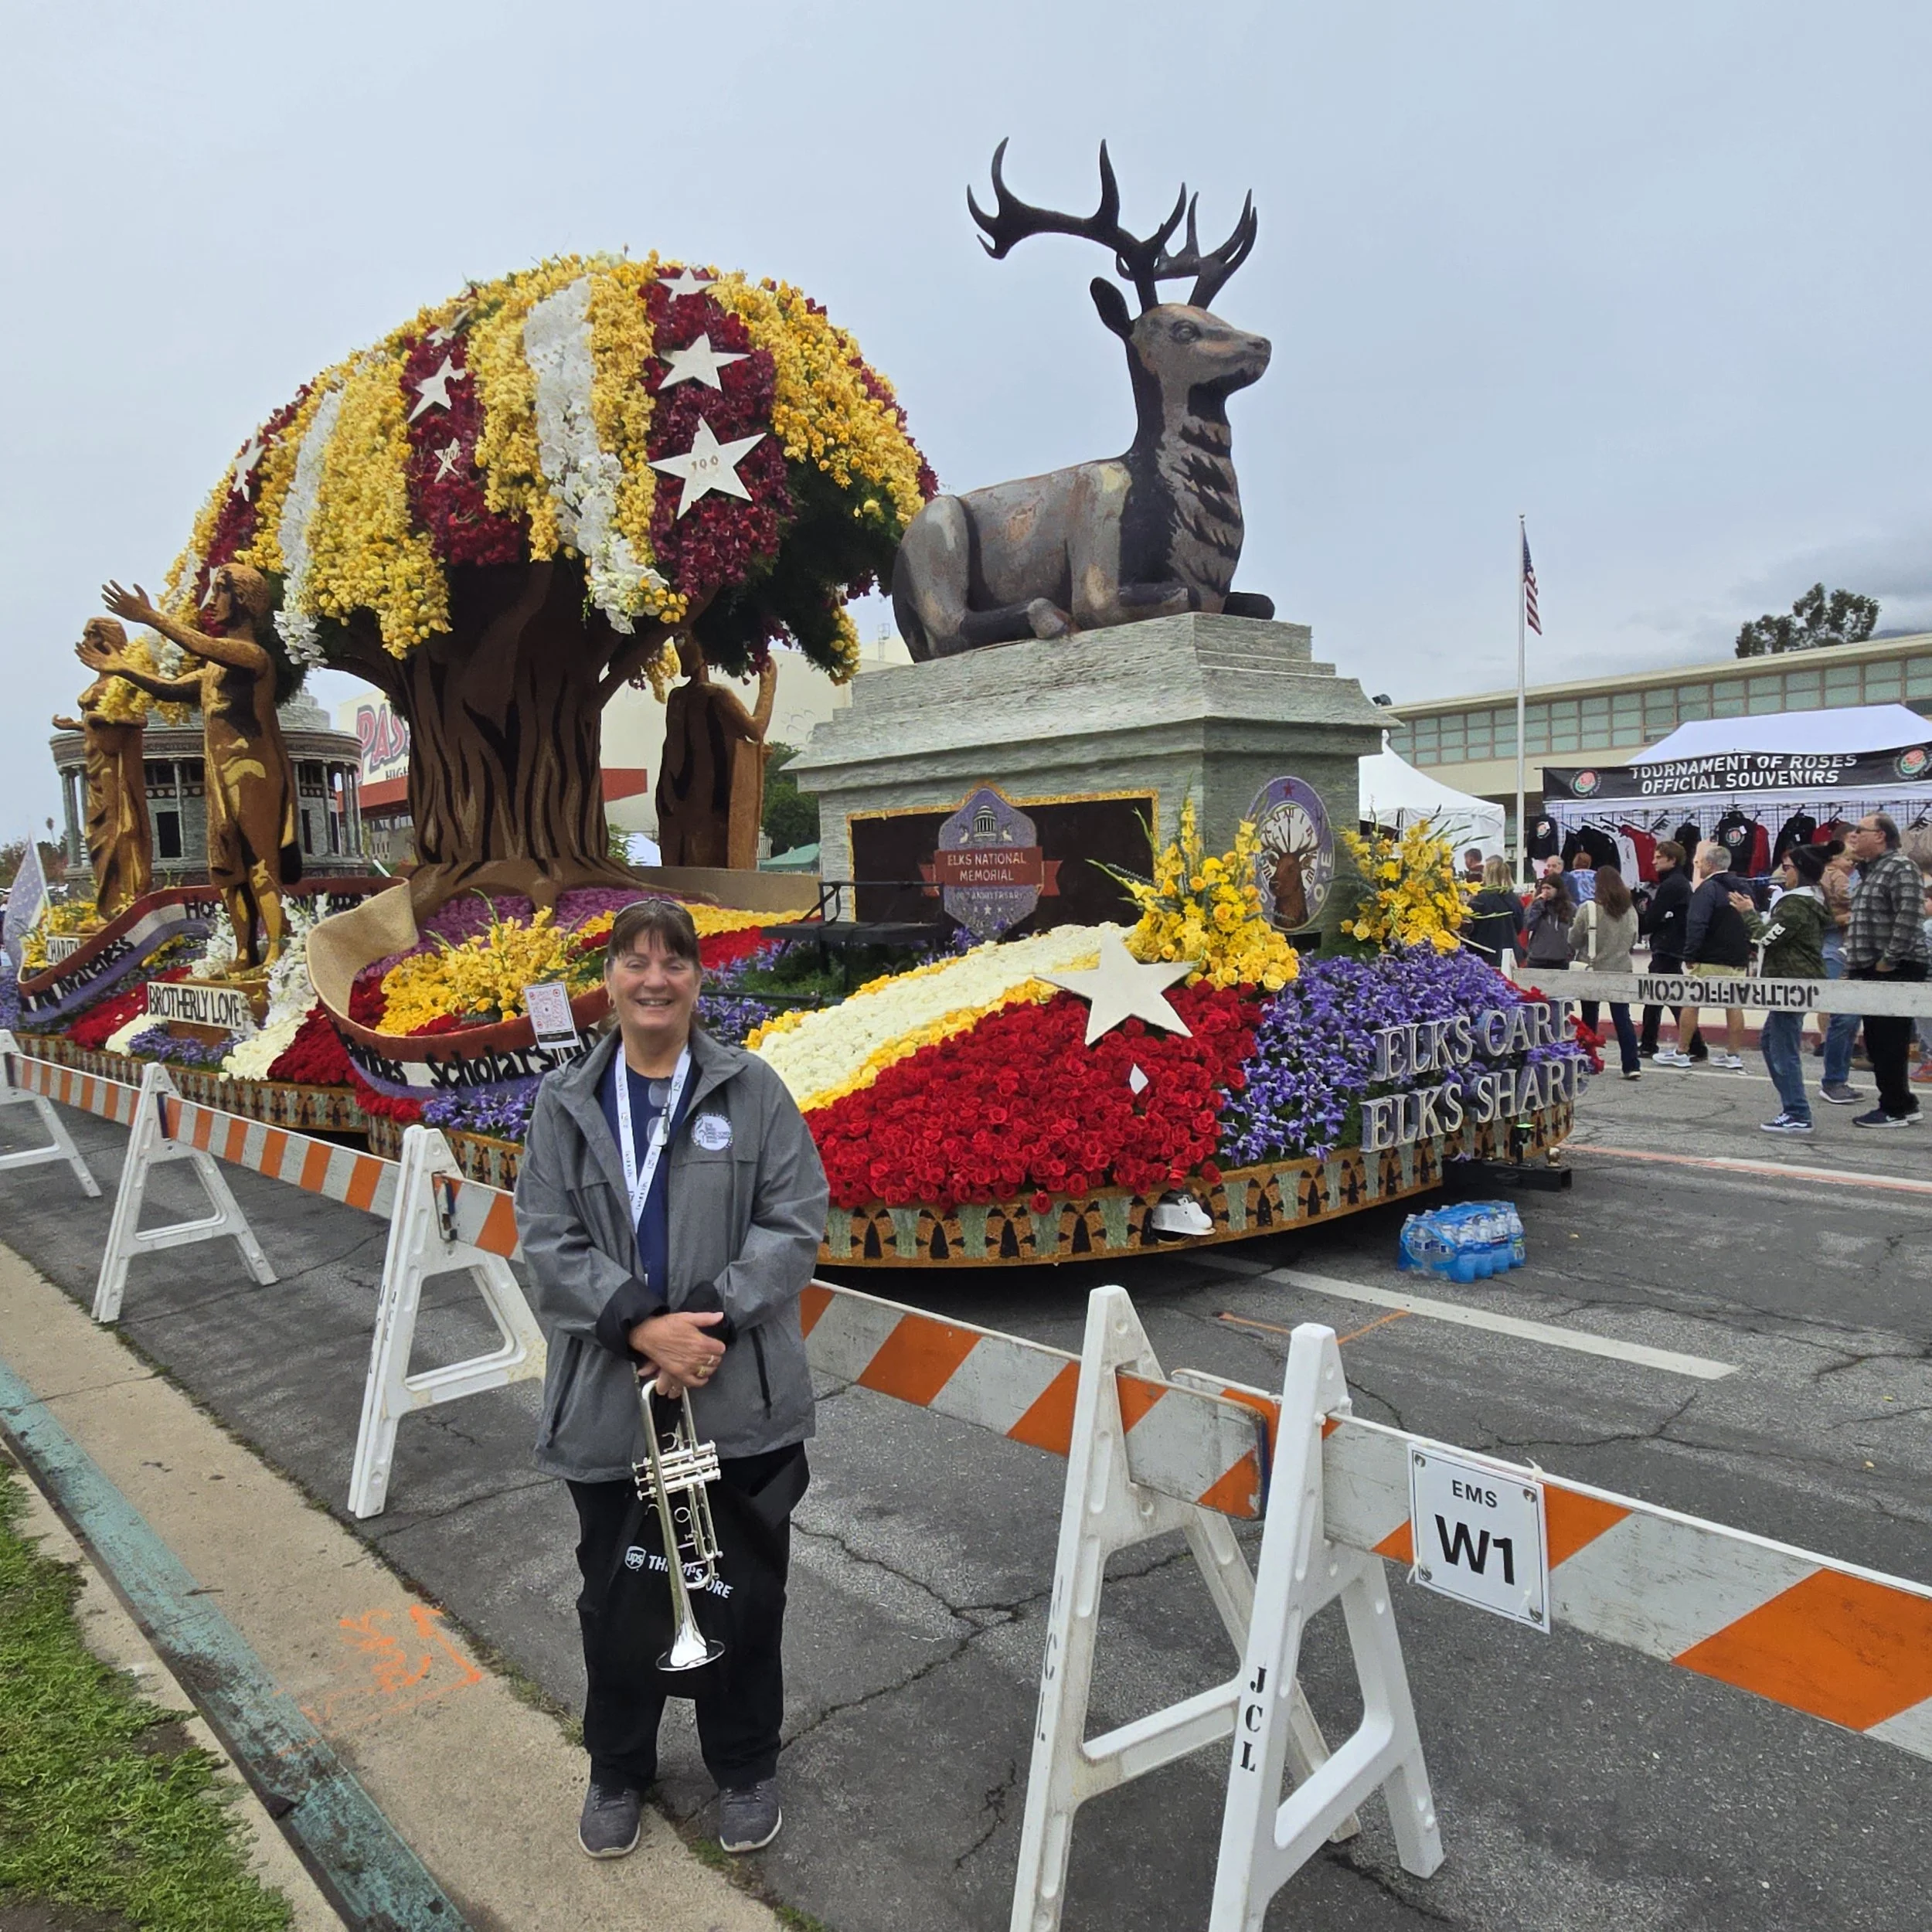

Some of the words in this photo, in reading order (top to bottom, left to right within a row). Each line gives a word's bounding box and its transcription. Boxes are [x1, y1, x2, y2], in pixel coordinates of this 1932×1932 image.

[1630, 754, 1751, 780] TOURNAMENT
[1757, 756, 1784, 769] OF
[1790, 754, 1857, 769] ROSES
[1641, 777, 1721, 794] OFFICIAL
[1725, 770, 1839, 788] SOUVENIRS
[947, 853, 971, 866] ELKS
[975, 852, 1026, 865] NATIONAL
[960, 869, 1014, 882] MEMORIAL
[148, 985, 208, 1022] BROTHERLY
[211, 991, 241, 1027] LOVE
[1638, 978, 1819, 1006] JCLTRAFFIC.COM
[1373, 1015, 1475, 1082] ELKS
[1481, 997, 1578, 1056] CARE
[1360, 1083, 1464, 1153] ELKS
[1477, 1054, 1590, 1124] SHARE
[1452, 1479, 1498, 1508] EMS
[1434, 1514, 1515, 1586] W1
[705, 1579, 733, 1599] ORE
[1240, 1666, 1267, 1772] JCL
